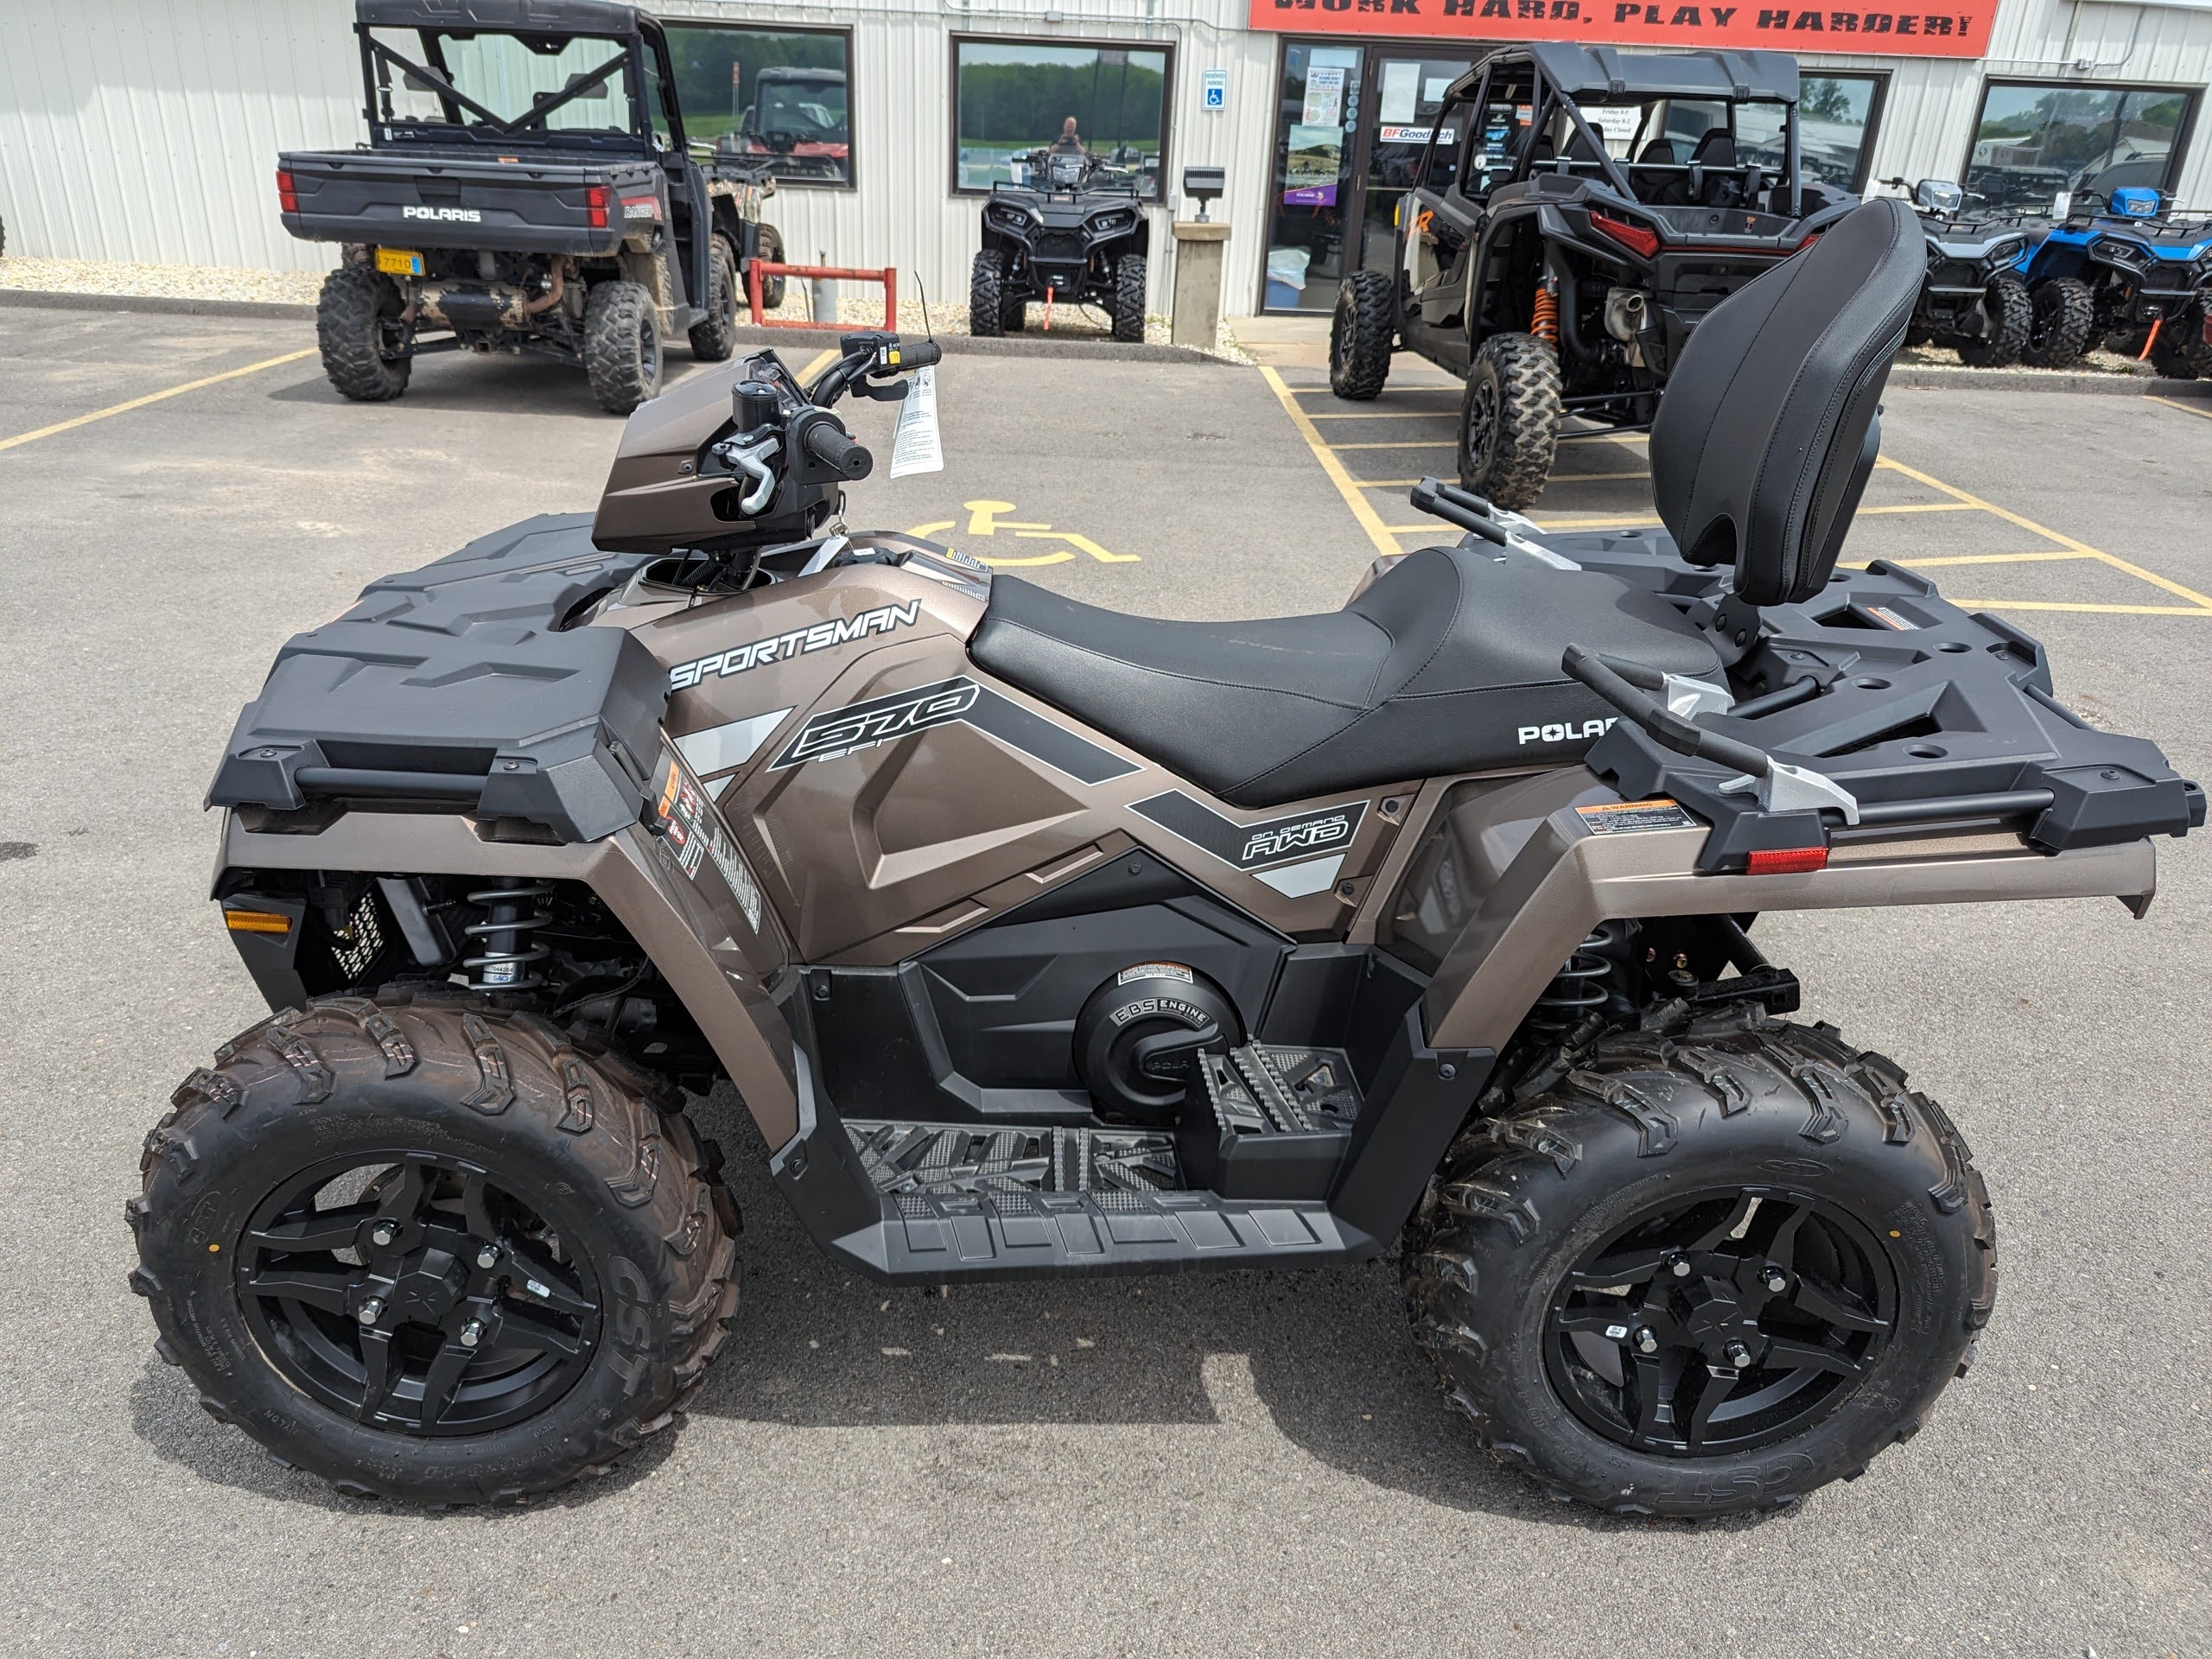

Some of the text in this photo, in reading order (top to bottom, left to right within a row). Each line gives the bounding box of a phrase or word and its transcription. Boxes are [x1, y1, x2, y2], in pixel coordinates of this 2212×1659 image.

[1442, 0, 1592, 24] HARD,
[1613, 3, 1738, 28] PLAY
[1755, 10, 1973, 37] HARDER!
[1383, 128, 1452, 140] BFGoodch
[403, 206, 481, 222] POLARIS
[623, 205, 653, 219] RANGER
[670, 601, 919, 691] SPORTSMAN
[791, 683, 981, 759] 570
[817, 739, 883, 763] EFI
[1242, 821, 1349, 861] AWD
[1251, 815, 1345, 841] ON DEMAND
[1115, 998, 1206, 1023] EBS ENGINE
[608, 1255, 652, 1397] CST
[1656, 1452, 1814, 1505] CST
